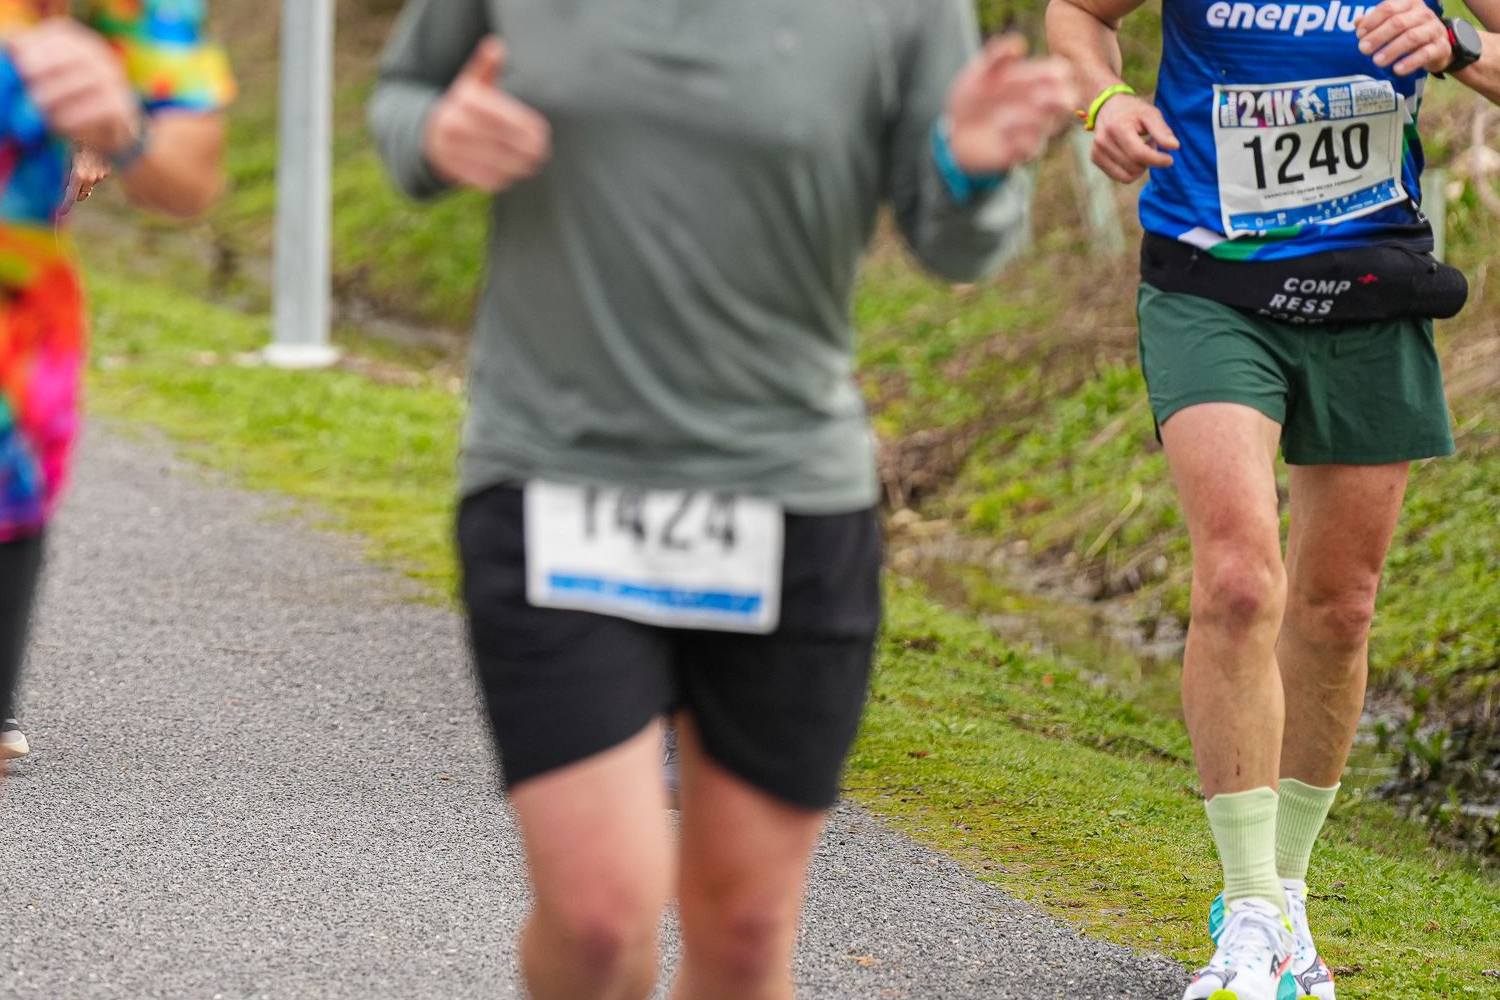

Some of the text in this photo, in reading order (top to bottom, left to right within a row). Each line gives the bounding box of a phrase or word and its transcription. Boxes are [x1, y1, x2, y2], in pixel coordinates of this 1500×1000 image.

[1206, 0, 1377, 36] enerplu
[1238, 89, 1297, 126] 21K
[1243, 123, 1370, 190] 1240
[1269, 293, 1334, 315] RESS
[1283, 277, 1351, 295] COMP
[583, 486, 737, 549] 1424
